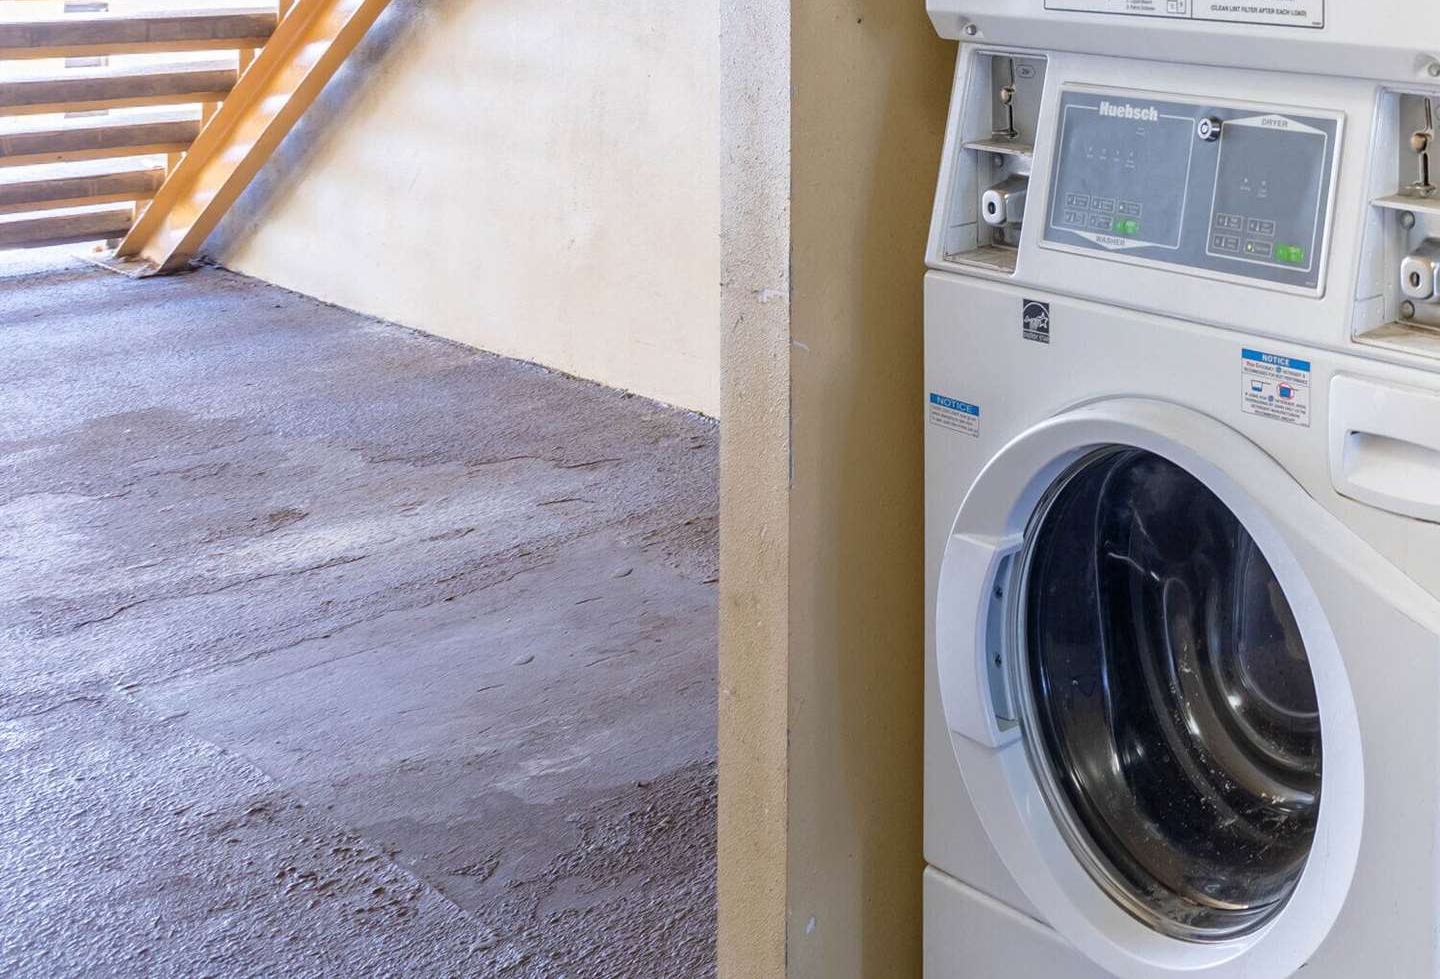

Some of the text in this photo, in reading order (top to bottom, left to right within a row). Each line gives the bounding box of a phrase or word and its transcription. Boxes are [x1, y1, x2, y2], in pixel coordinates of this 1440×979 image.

[1229, 5, 1241, 13] LINT
[1241, 6, 1258, 14] FILTER
[1258, 7, 1275, 15] AFTER
[1275, 8, 1290, 16] EACH
[1290, 9, 1307, 17] LOAD)
[1099, 100, 1159, 121] Huebsch
[1261, 118, 1288, 128] DRYER
[1095, 235, 1126, 247] WASHER
[1262, 354, 1290, 366] NOTICE
[936, 395, 974, 414] NOTICE
